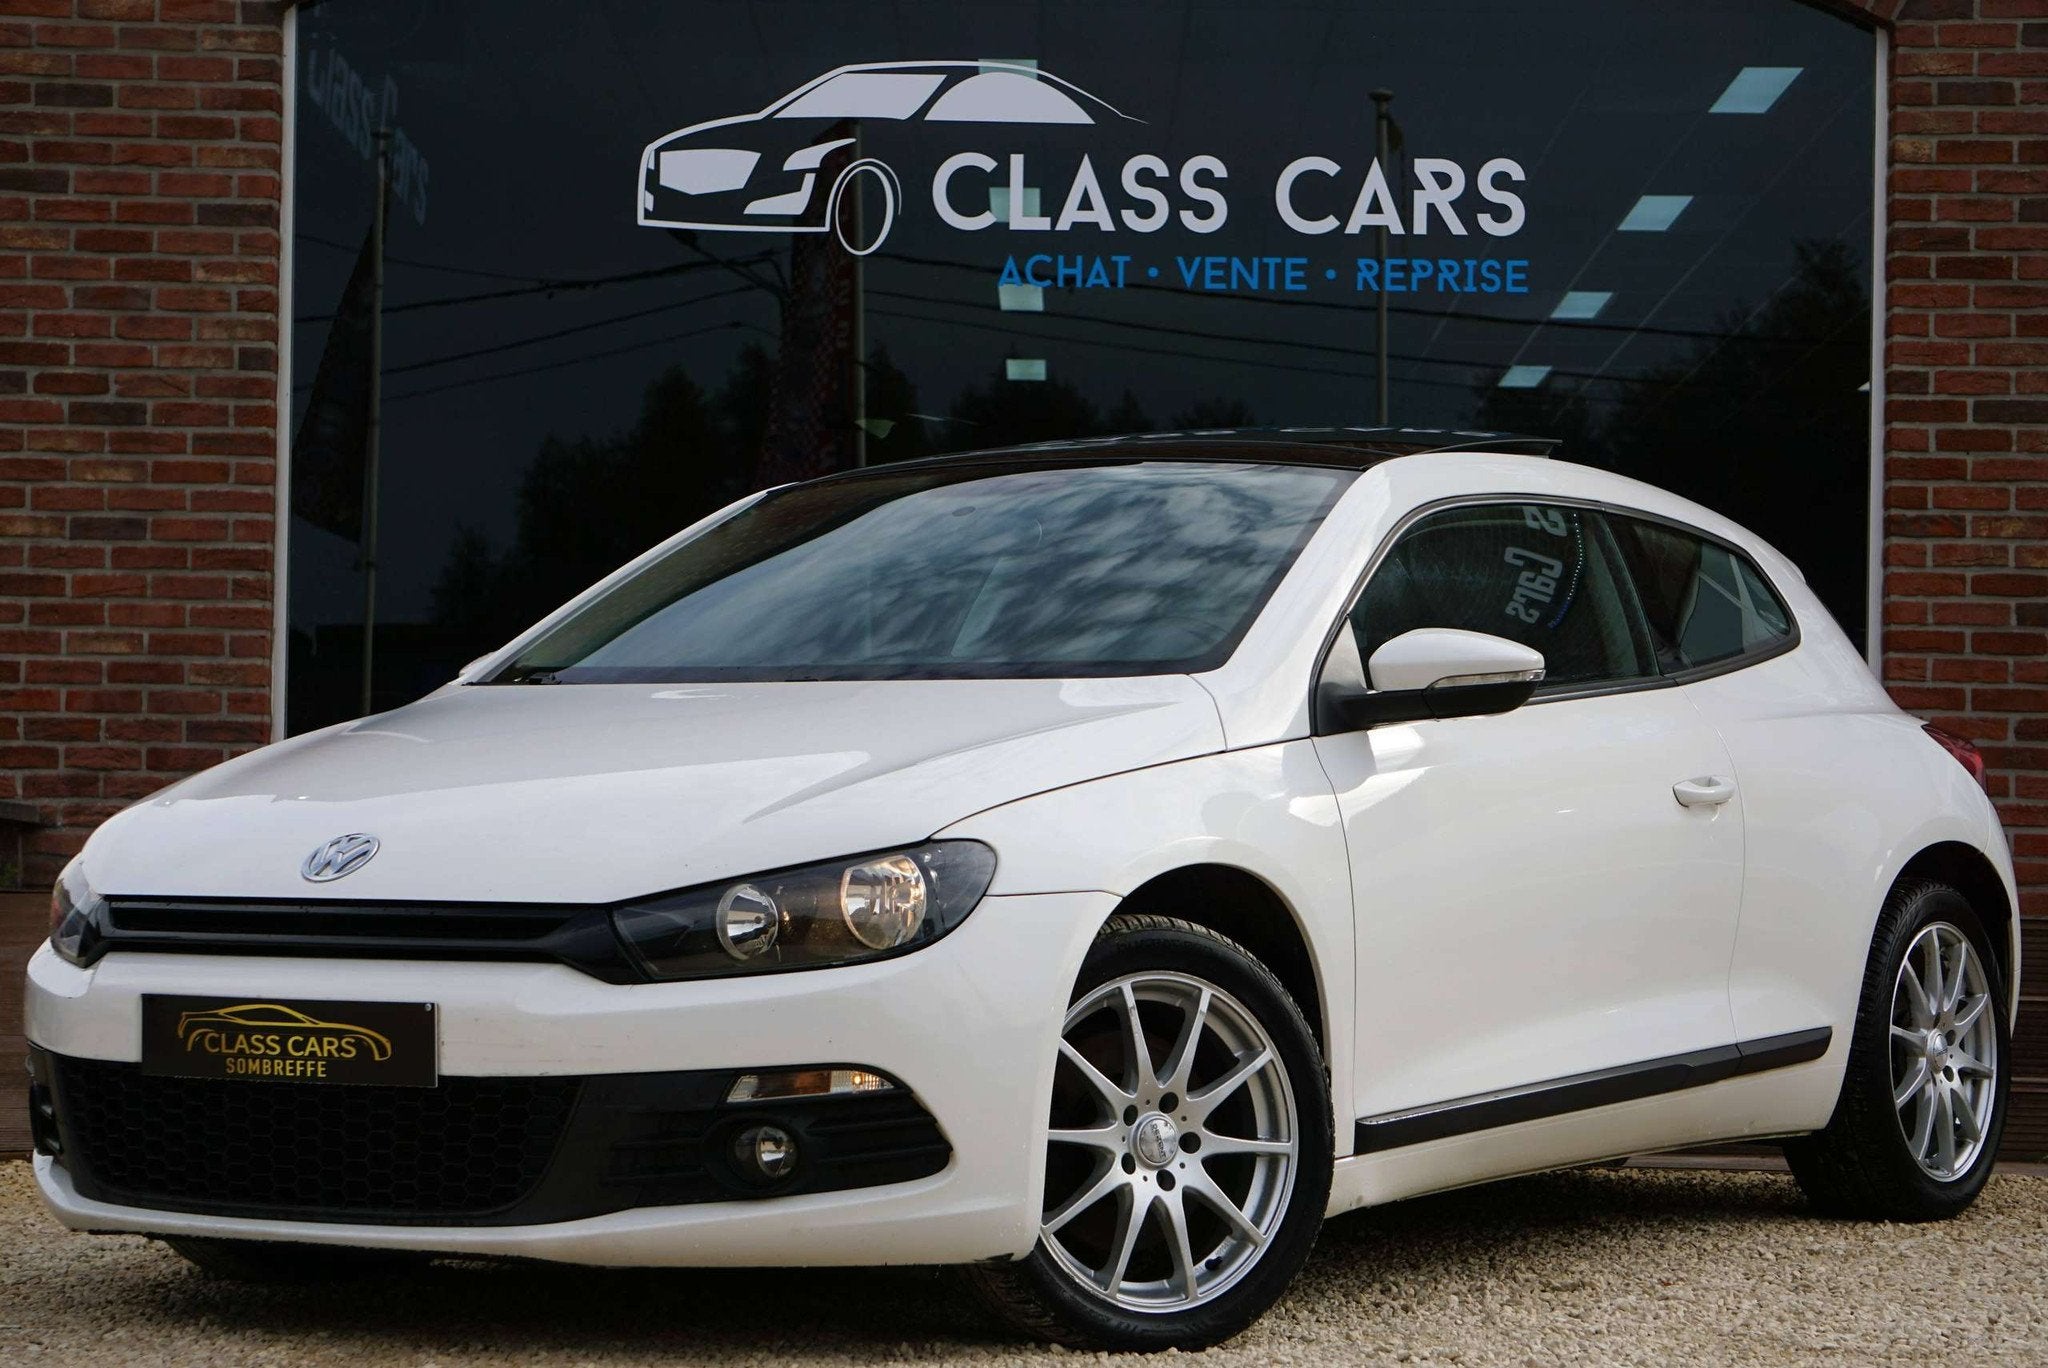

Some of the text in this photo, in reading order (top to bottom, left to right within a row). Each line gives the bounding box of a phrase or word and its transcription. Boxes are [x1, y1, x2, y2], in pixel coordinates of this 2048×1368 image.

[933, 152, 1527, 238] CLASS CARS
[998, 253, 1530, 295] ACHAT VENTE REPRISE
[204, 1032, 357, 1058] CLASS CARS
[225, 1057, 327, 1078] SOMBREFFE
